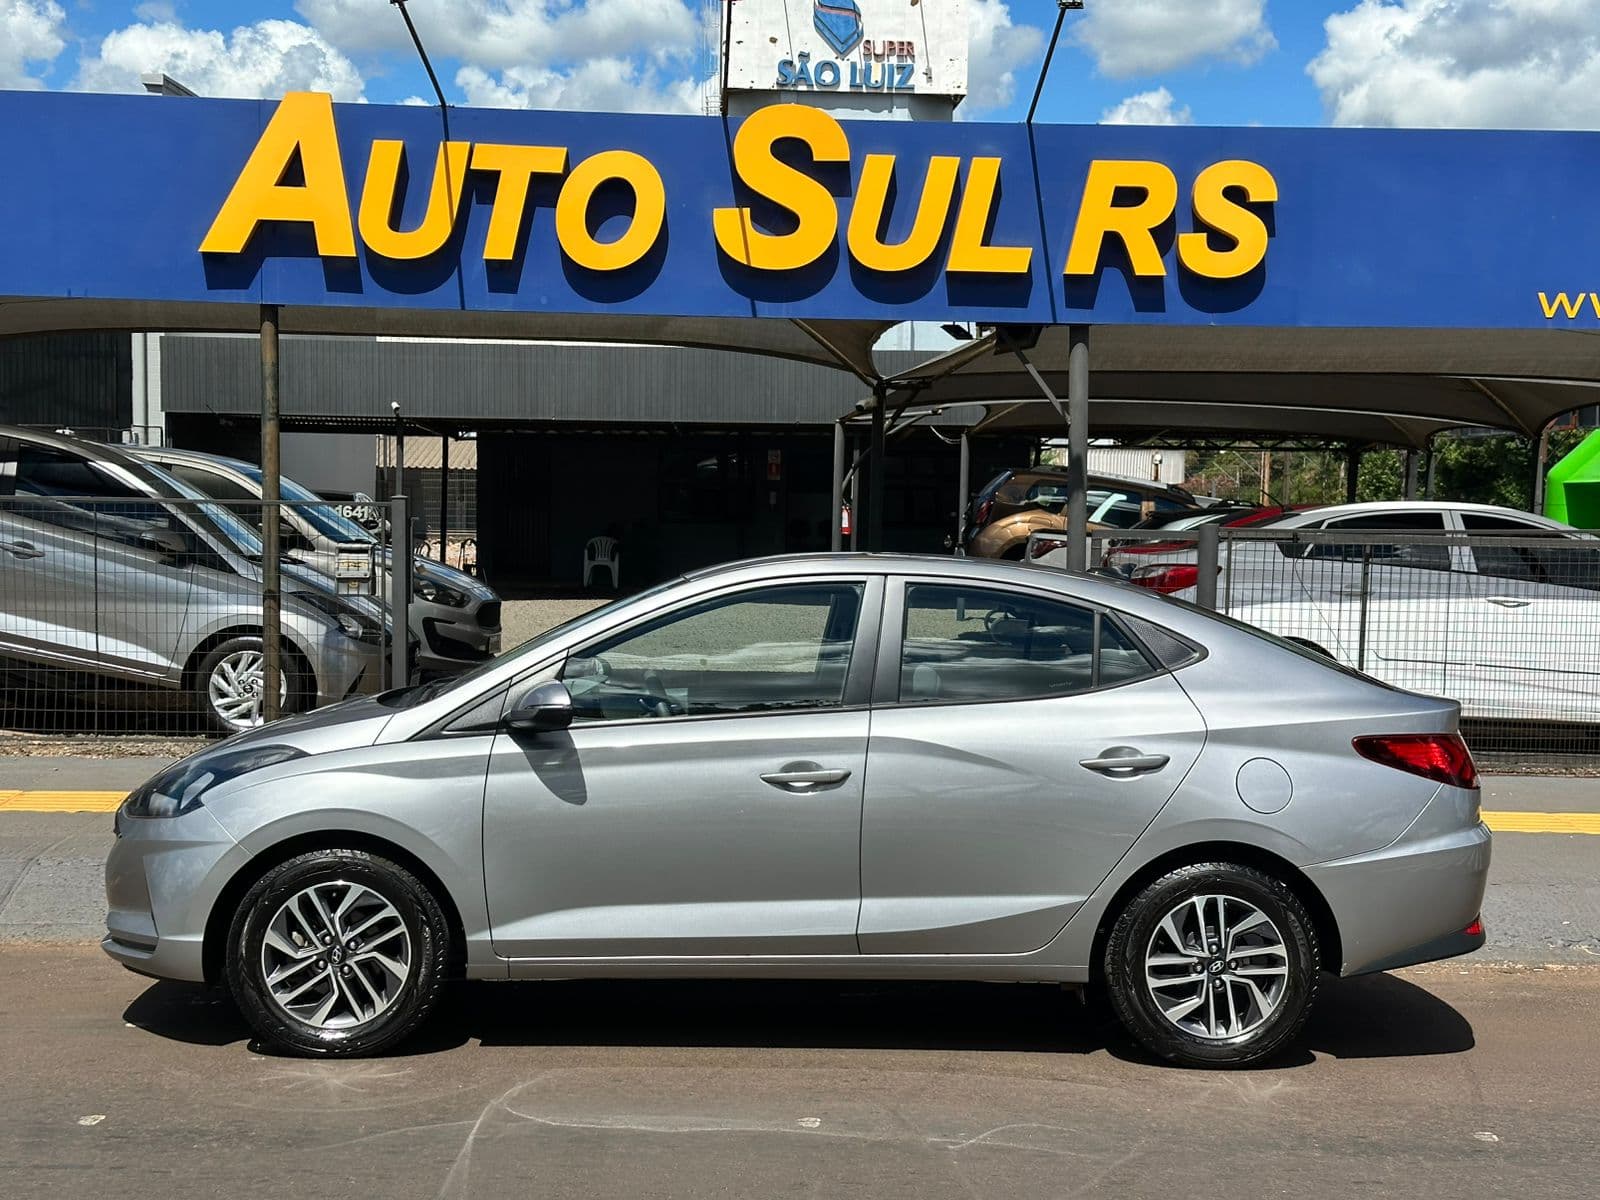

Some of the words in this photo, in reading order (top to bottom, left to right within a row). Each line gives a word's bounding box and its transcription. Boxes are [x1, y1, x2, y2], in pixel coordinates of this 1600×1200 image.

[863, 39, 915, 58] SUPER
[777, 51, 840, 88] SÃO
[850, 61, 915, 90] LUIZ
[198, 91, 666, 271] AUTO
[712, 103, 1033, 272] SUL
[1063, 159, 1279, 279] RS
